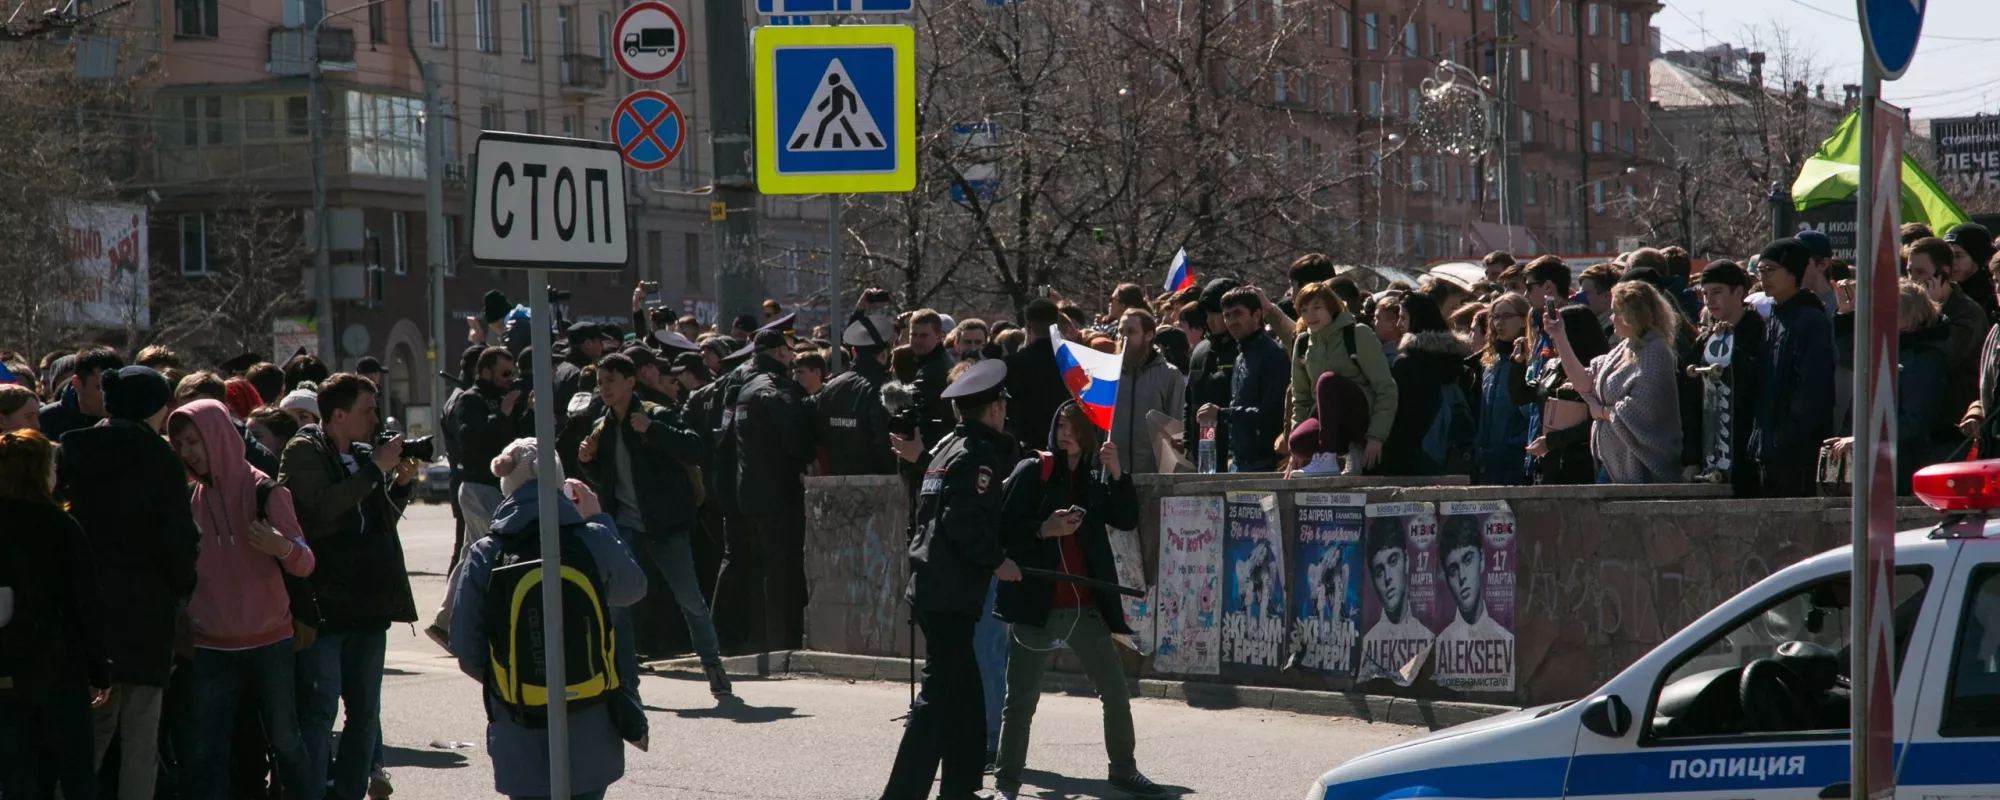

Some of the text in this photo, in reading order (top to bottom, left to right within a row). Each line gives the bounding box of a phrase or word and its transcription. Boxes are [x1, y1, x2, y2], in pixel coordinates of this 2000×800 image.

[1943, 151, 1999, 170] ЛЕЧЕ
[490, 161, 612, 244] СТОП
[830, 417, 857, 428] ПОЛИЦИЯ
[1229, 506, 1237, 518] 25
[1238, 506, 1262, 519] АПРЕЛЯ
[1299, 509, 1307, 521] 25
[1308, 509, 1333, 522] АПРЕЛЯ
[1416, 551, 1430, 572] 17
[1492, 550, 1508, 572] 17
[1410, 573, 1433, 585] МАРТА
[1487, 572, 1513, 585] МАРТА
[1234, 639, 1278, 667] БРЕРИ
[1301, 644, 1350, 671] БРЕРИ
[1438, 640, 1513, 674] ALEKSEEV
[1669, 755, 1805, 780] ПОЛИЦИЯ
